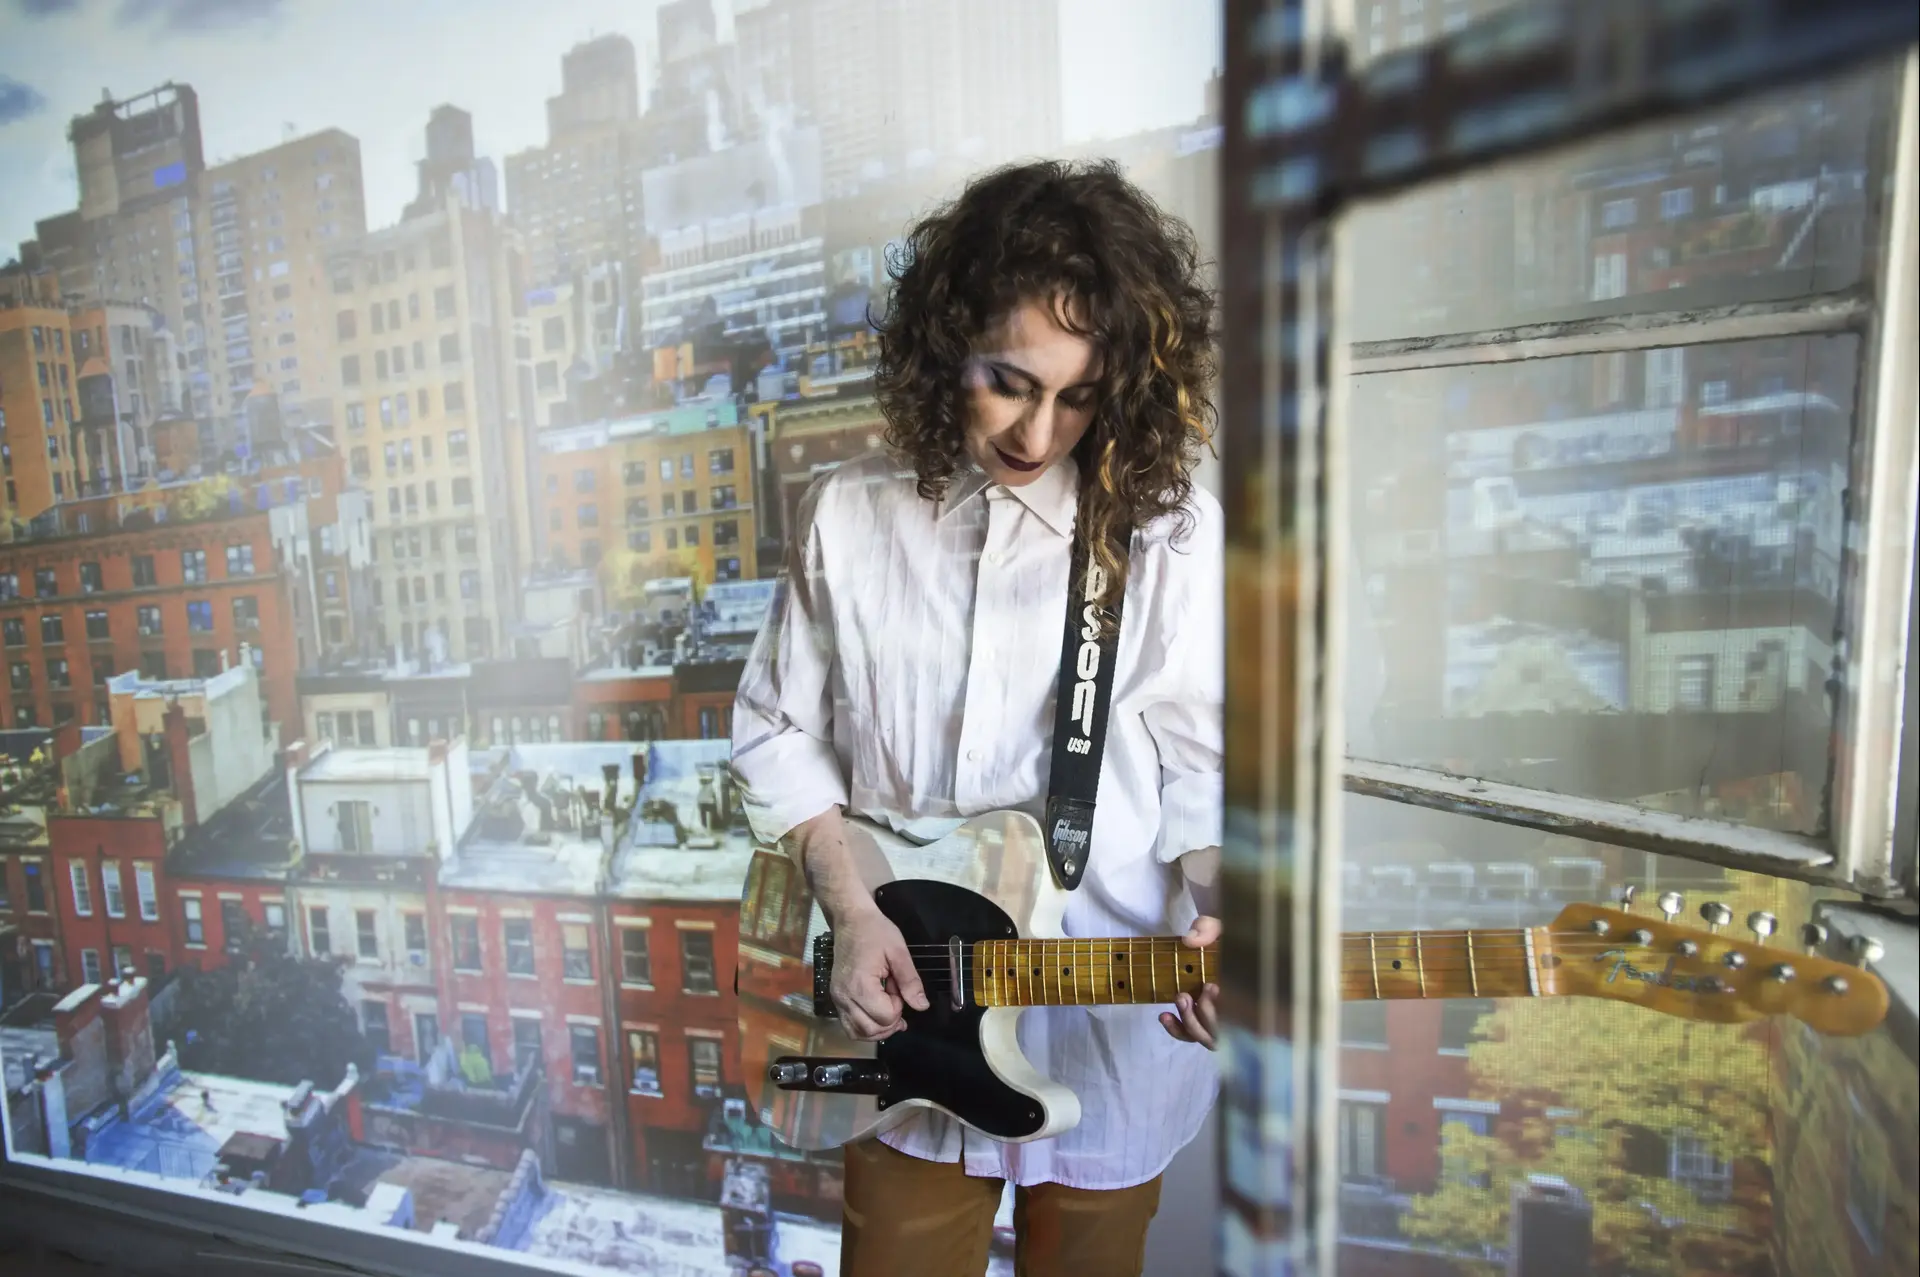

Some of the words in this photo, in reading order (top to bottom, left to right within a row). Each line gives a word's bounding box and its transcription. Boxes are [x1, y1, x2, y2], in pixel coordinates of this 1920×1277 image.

[1071, 538, 1108, 737] bson
[1066, 737, 1092, 755] USA
[1053, 819, 1087, 849] Gibson
